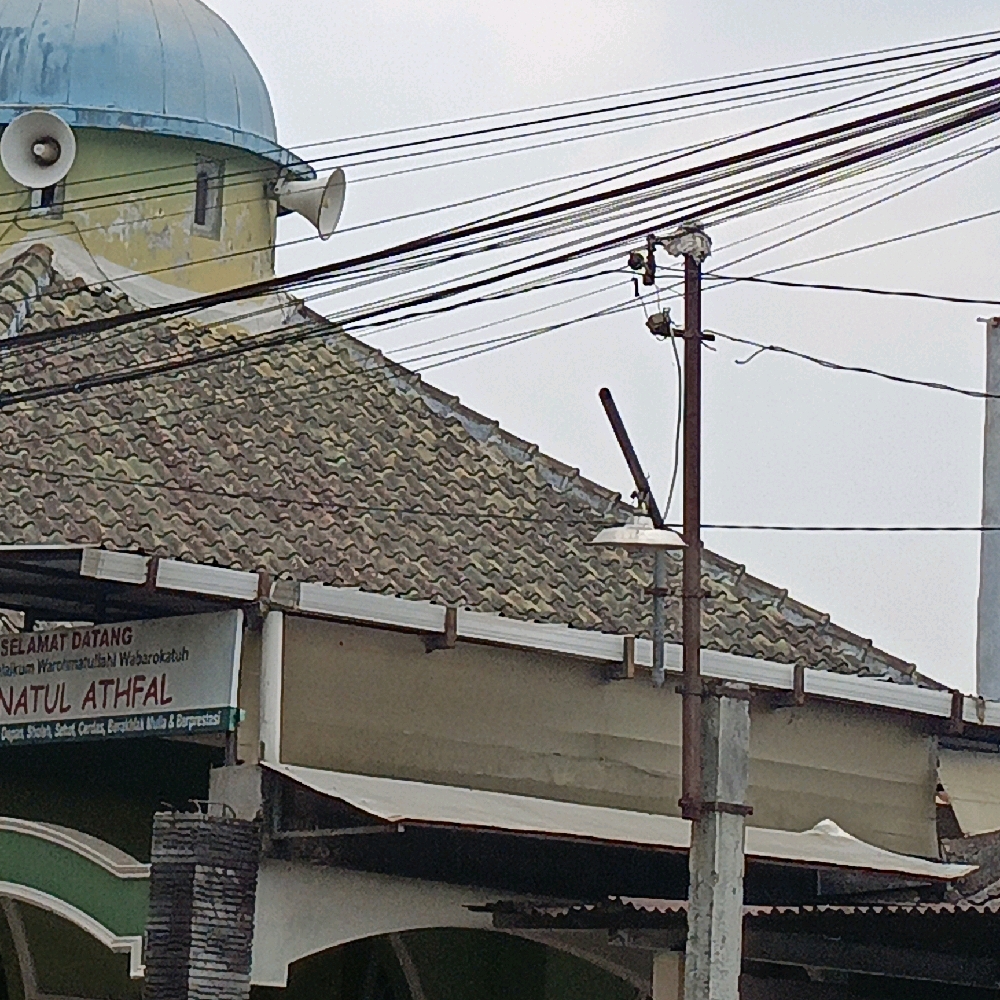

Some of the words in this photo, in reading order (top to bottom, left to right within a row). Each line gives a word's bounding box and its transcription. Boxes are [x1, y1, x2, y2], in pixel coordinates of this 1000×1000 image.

[0, 632, 66, 656] SELAMAT
[71, 626, 133, 650] DATANG
[81, 673, 173, 711] ATHFAL
[168, 713, 175, 729] &
[176, 710, 222, 731] Berprestasi
